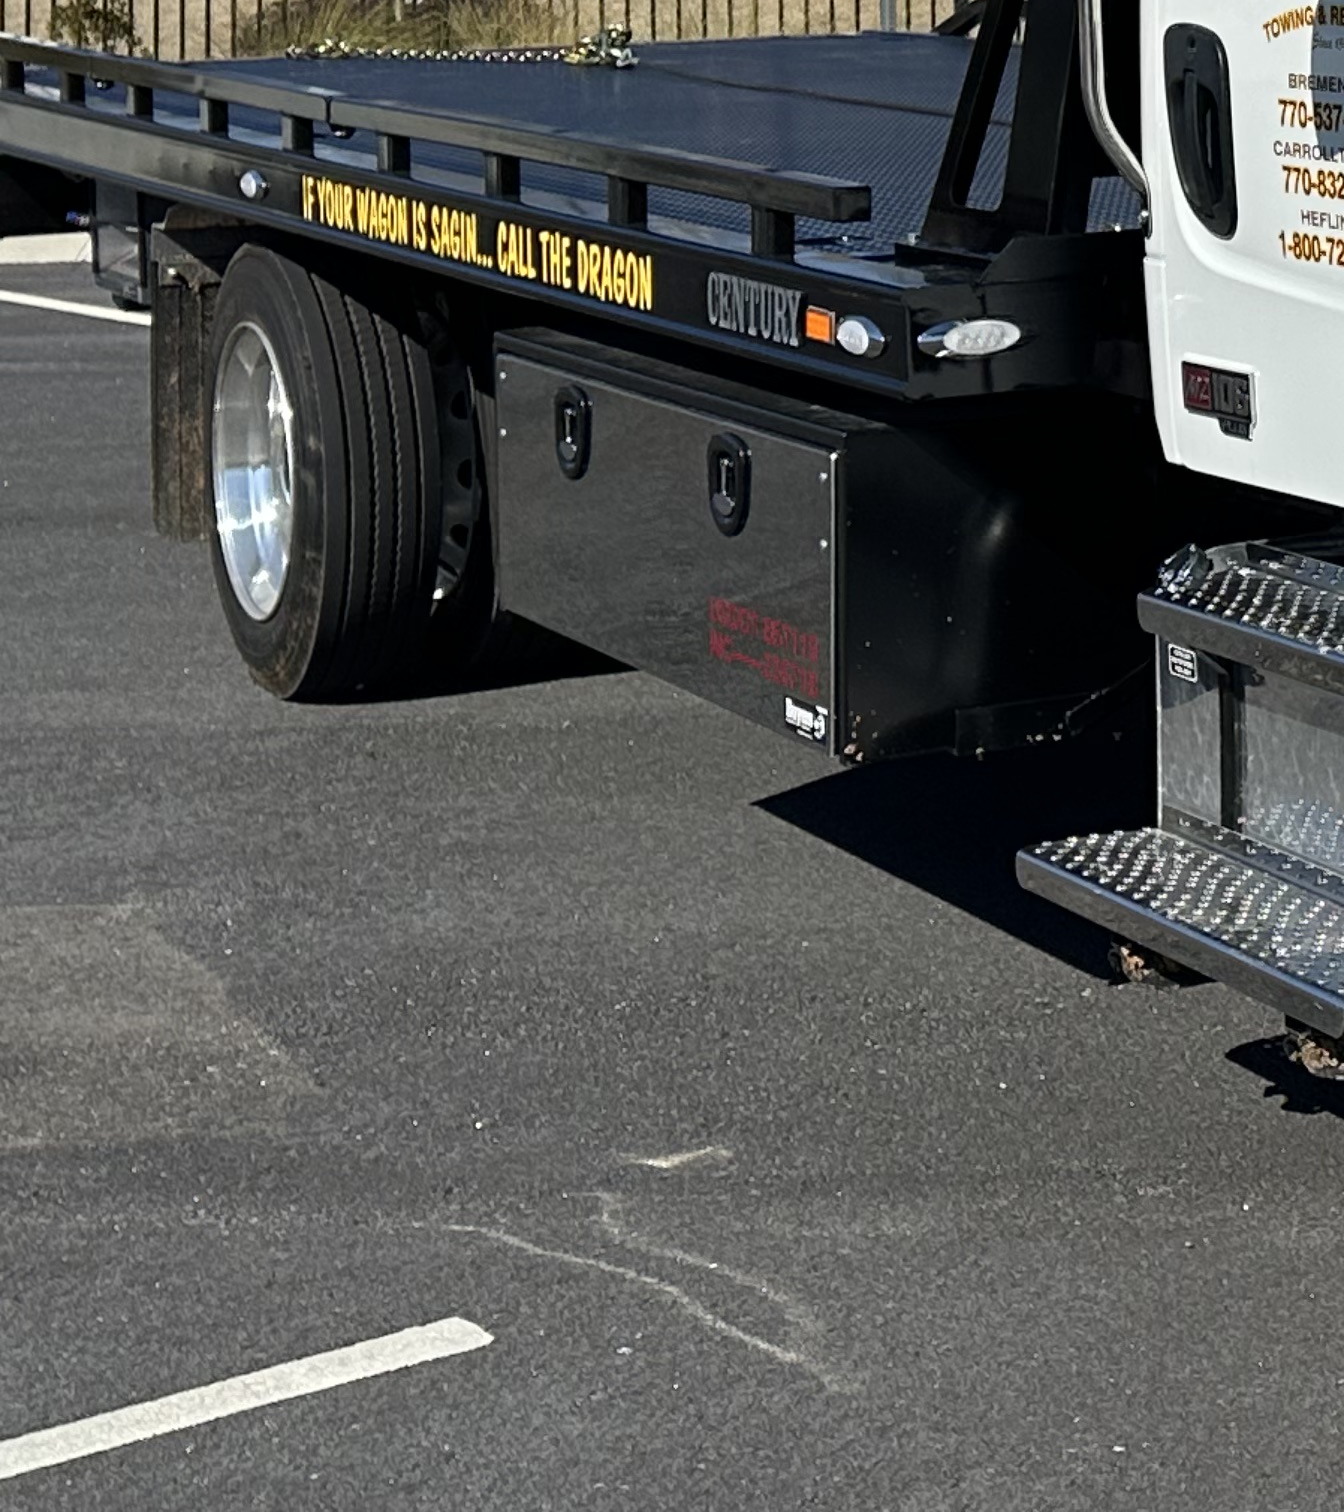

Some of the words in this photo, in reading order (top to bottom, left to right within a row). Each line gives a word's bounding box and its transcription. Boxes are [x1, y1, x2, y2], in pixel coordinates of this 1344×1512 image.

[1263, 6, 1315, 42] TOWING
[1316, 5, 1326, 25] &
[302, 174, 315, 223] IF
[316, 176, 354, 233] YOUR
[356, 187, 408, 245] WAGON
[412, 200, 427, 251] IS
[430, 205, 494, 269] SAGIN...
[497, 221, 537, 279] CALL
[540, 231, 571, 289] THE
[577, 239, 653, 311] DRAGON
[707, 271, 803, 347] CENTURY
